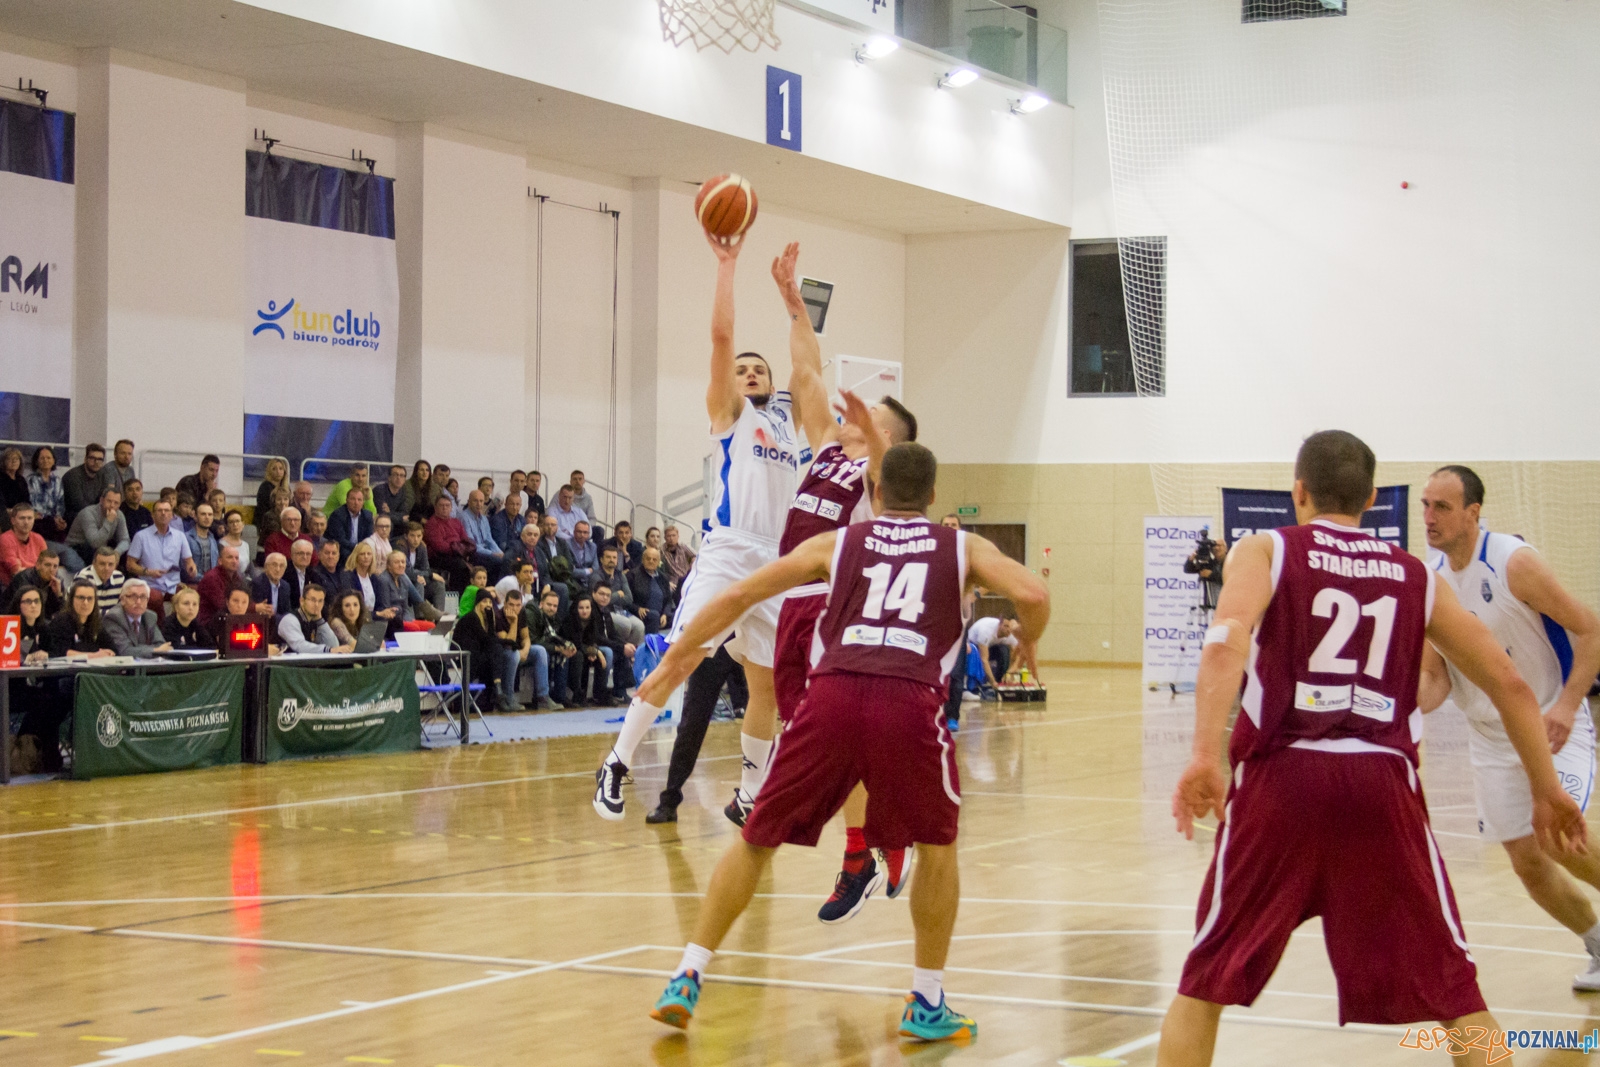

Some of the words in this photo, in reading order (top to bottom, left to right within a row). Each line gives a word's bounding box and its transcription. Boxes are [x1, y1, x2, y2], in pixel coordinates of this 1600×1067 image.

[778, 79, 792, 141] 1
[293, 302, 381, 339] funclub
[293, 330, 328, 344] biuro
[331, 337, 380, 352] podróży
[819, 505, 836, 517] ZZO
[864, 536, 937, 556] STARGARD
[1307, 550, 1406, 582] STARGARD
[862, 562, 929, 623] 14
[1145, 577, 1200, 590] POZna
[2, 620, 19, 655] 5
[1308, 587, 1399, 680] 21
[128, 717, 185, 733] POLITECHNIKA
[186, 711, 230, 728] POZNAŃSKA
